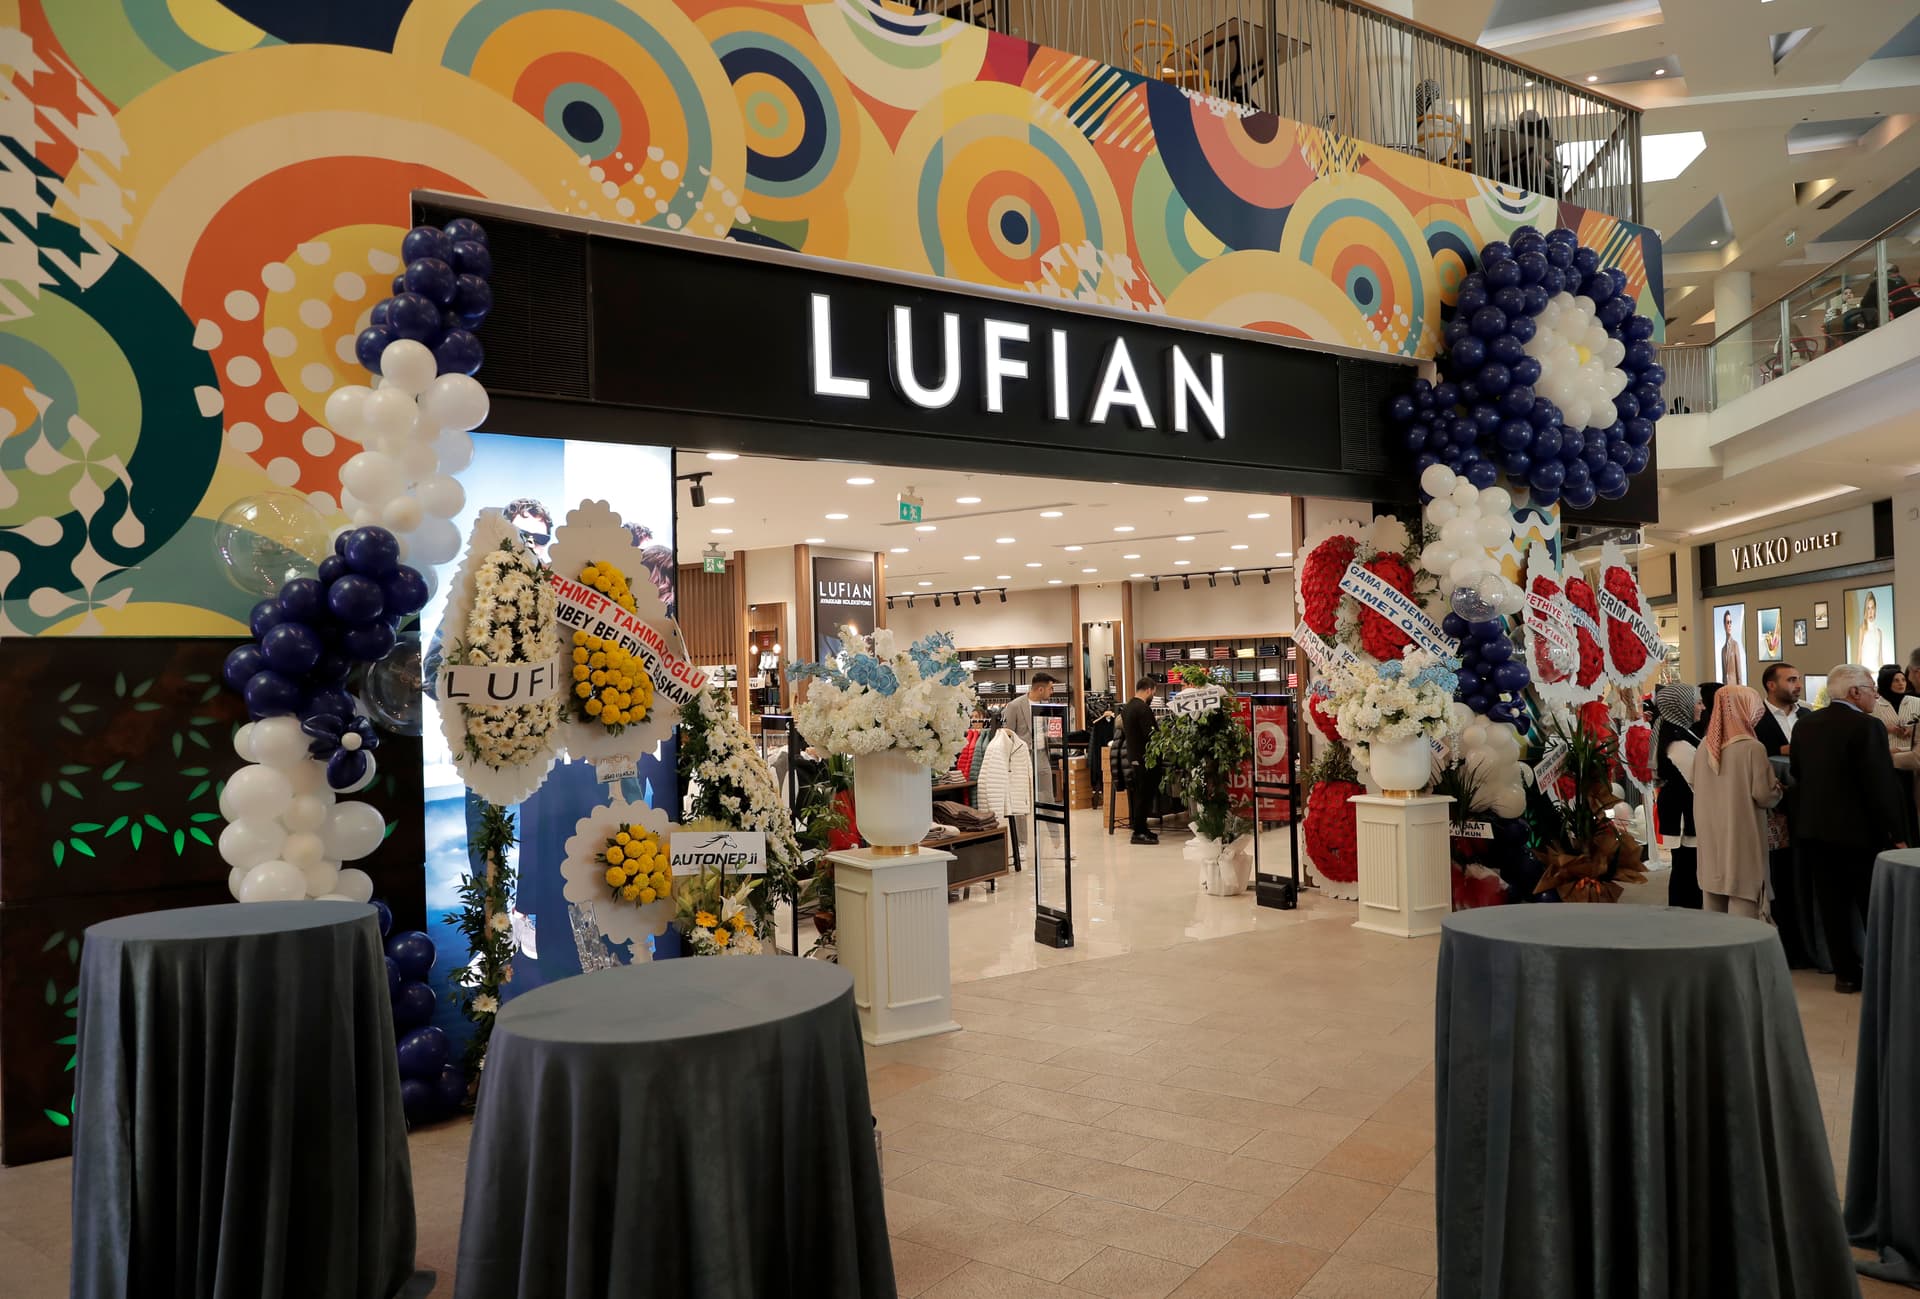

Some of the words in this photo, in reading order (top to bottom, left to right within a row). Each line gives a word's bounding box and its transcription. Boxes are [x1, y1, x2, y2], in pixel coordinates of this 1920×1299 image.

[811, 292, 1225, 439] LUFIAN
[1731, 537, 1788, 572] VAKKO
[1794, 532, 1838, 554] OUTLET
[819, 581, 872, 599] LUFIAN
[1350, 566, 1381, 590] GAMA
[1341, 580, 1399, 617] AHMET
[548, 573, 611, 615] EHMET
[612, 607, 705, 689] TAHMAZOĞLU
[447, 662, 554, 700] LUFI
